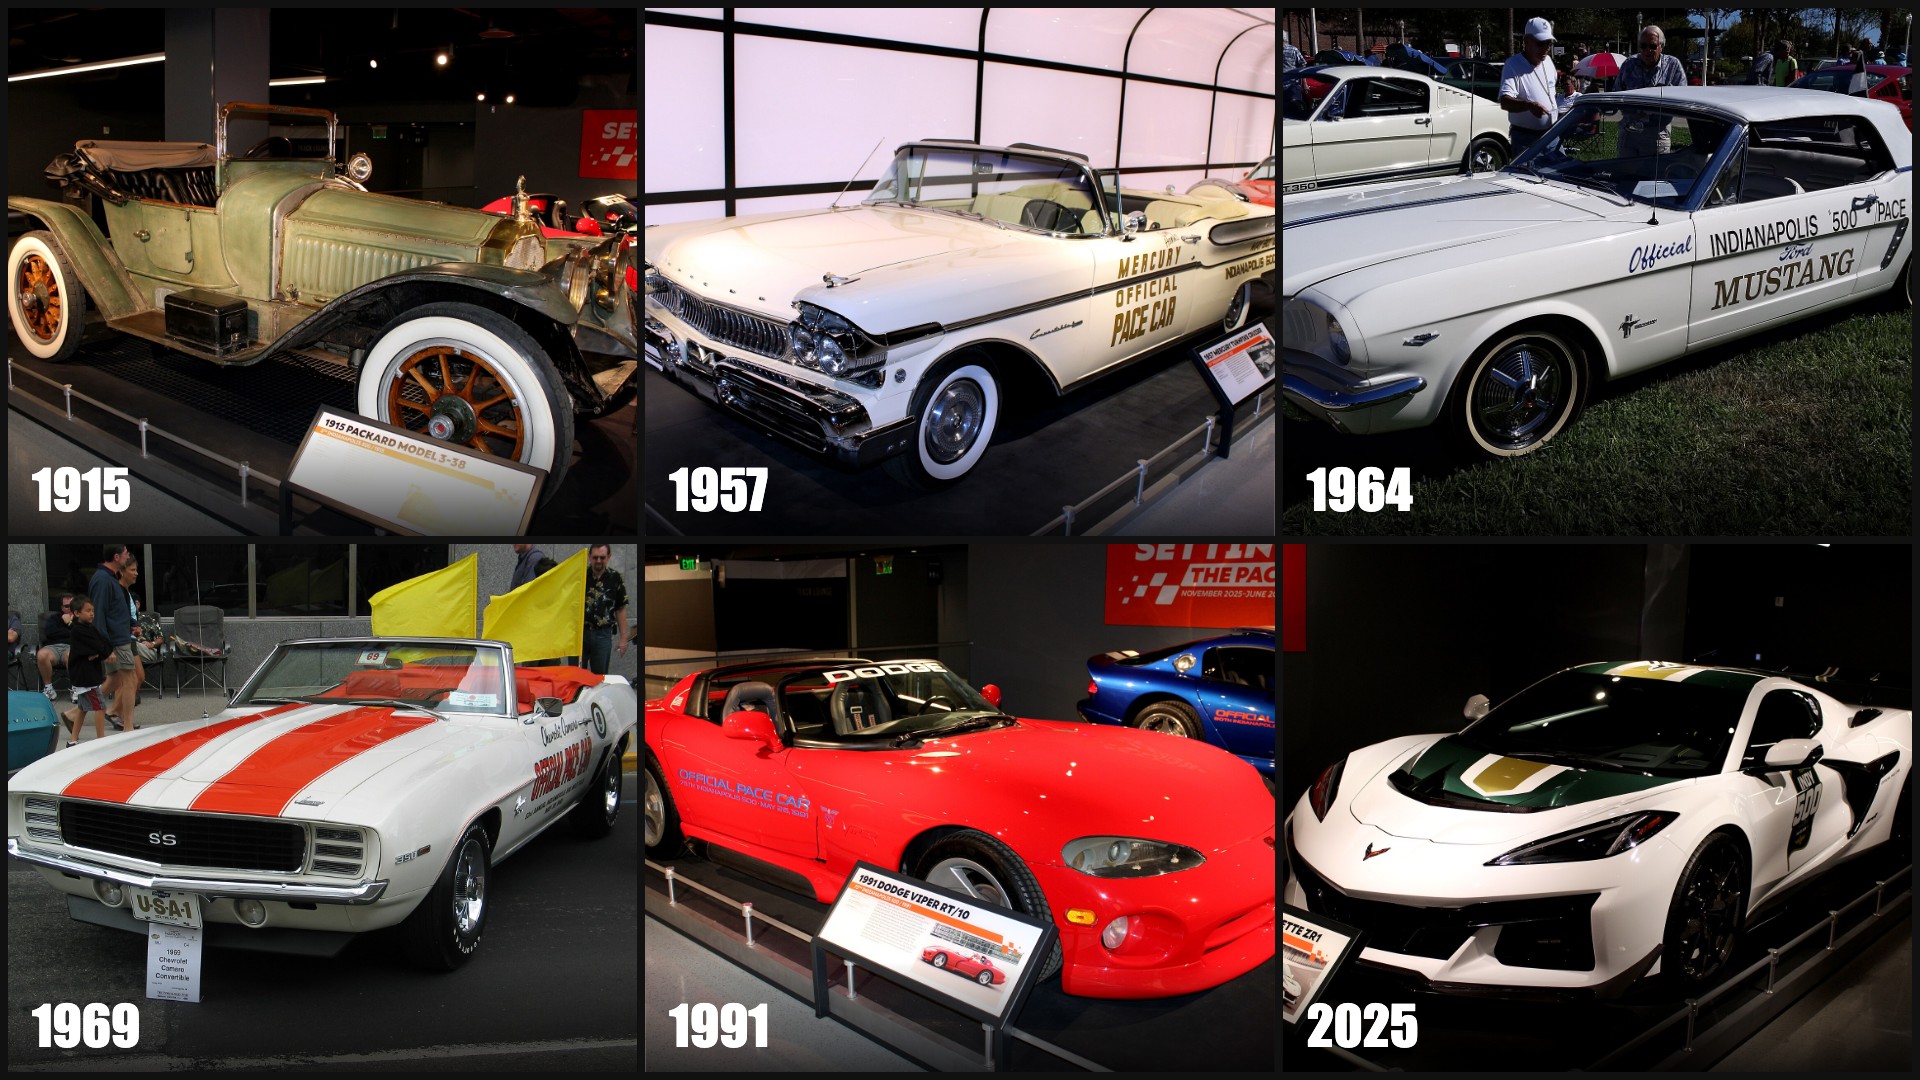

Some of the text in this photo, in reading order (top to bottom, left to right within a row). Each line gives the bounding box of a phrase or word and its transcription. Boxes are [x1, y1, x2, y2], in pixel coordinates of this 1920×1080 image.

[602, 122, 637, 139] SE
[1628, 234, 1693, 274] Official
[1709, 214, 1819, 257] INDIANAPOLIS
[1877, 199, 1907, 222] PACE
[1117, 246, 1182, 279] MERCURY
[1778, 242, 1814, 262] Ford
[1710, 248, 1856, 311] MUSTANG
[1115, 274, 1178, 308] OFFICIAL
[1110, 295, 1177, 347] PACE CAR
[325, 418, 467, 470] 1915 PACKARD MODEL 3-38
[1191, 566, 1275, 583] THE PAC
[1181, 590, 1222, 598] NOVEMBER
[366, 652, 380, 661] 69
[823, 662, 948, 684] DODGE
[1215, 709, 1274, 723] OFFICIAL
[531, 736, 592, 801] OFFICIAL PACE CAR
[678, 768, 811, 810] OFFICIAL PACE CAR
[1797, 769, 1815, 791] INDY
[1792, 782, 1822, 827] 500
[149, 832, 177, 846] SS
[859, 874, 970, 920] 1991 DODGE VIPER RT/10
[1302, 928, 1323, 943] ZR1
[158, 956, 188, 965] Chevrolet
[161, 965, 185, 973] Camaro
[155, 972, 190, 982] Convertible
